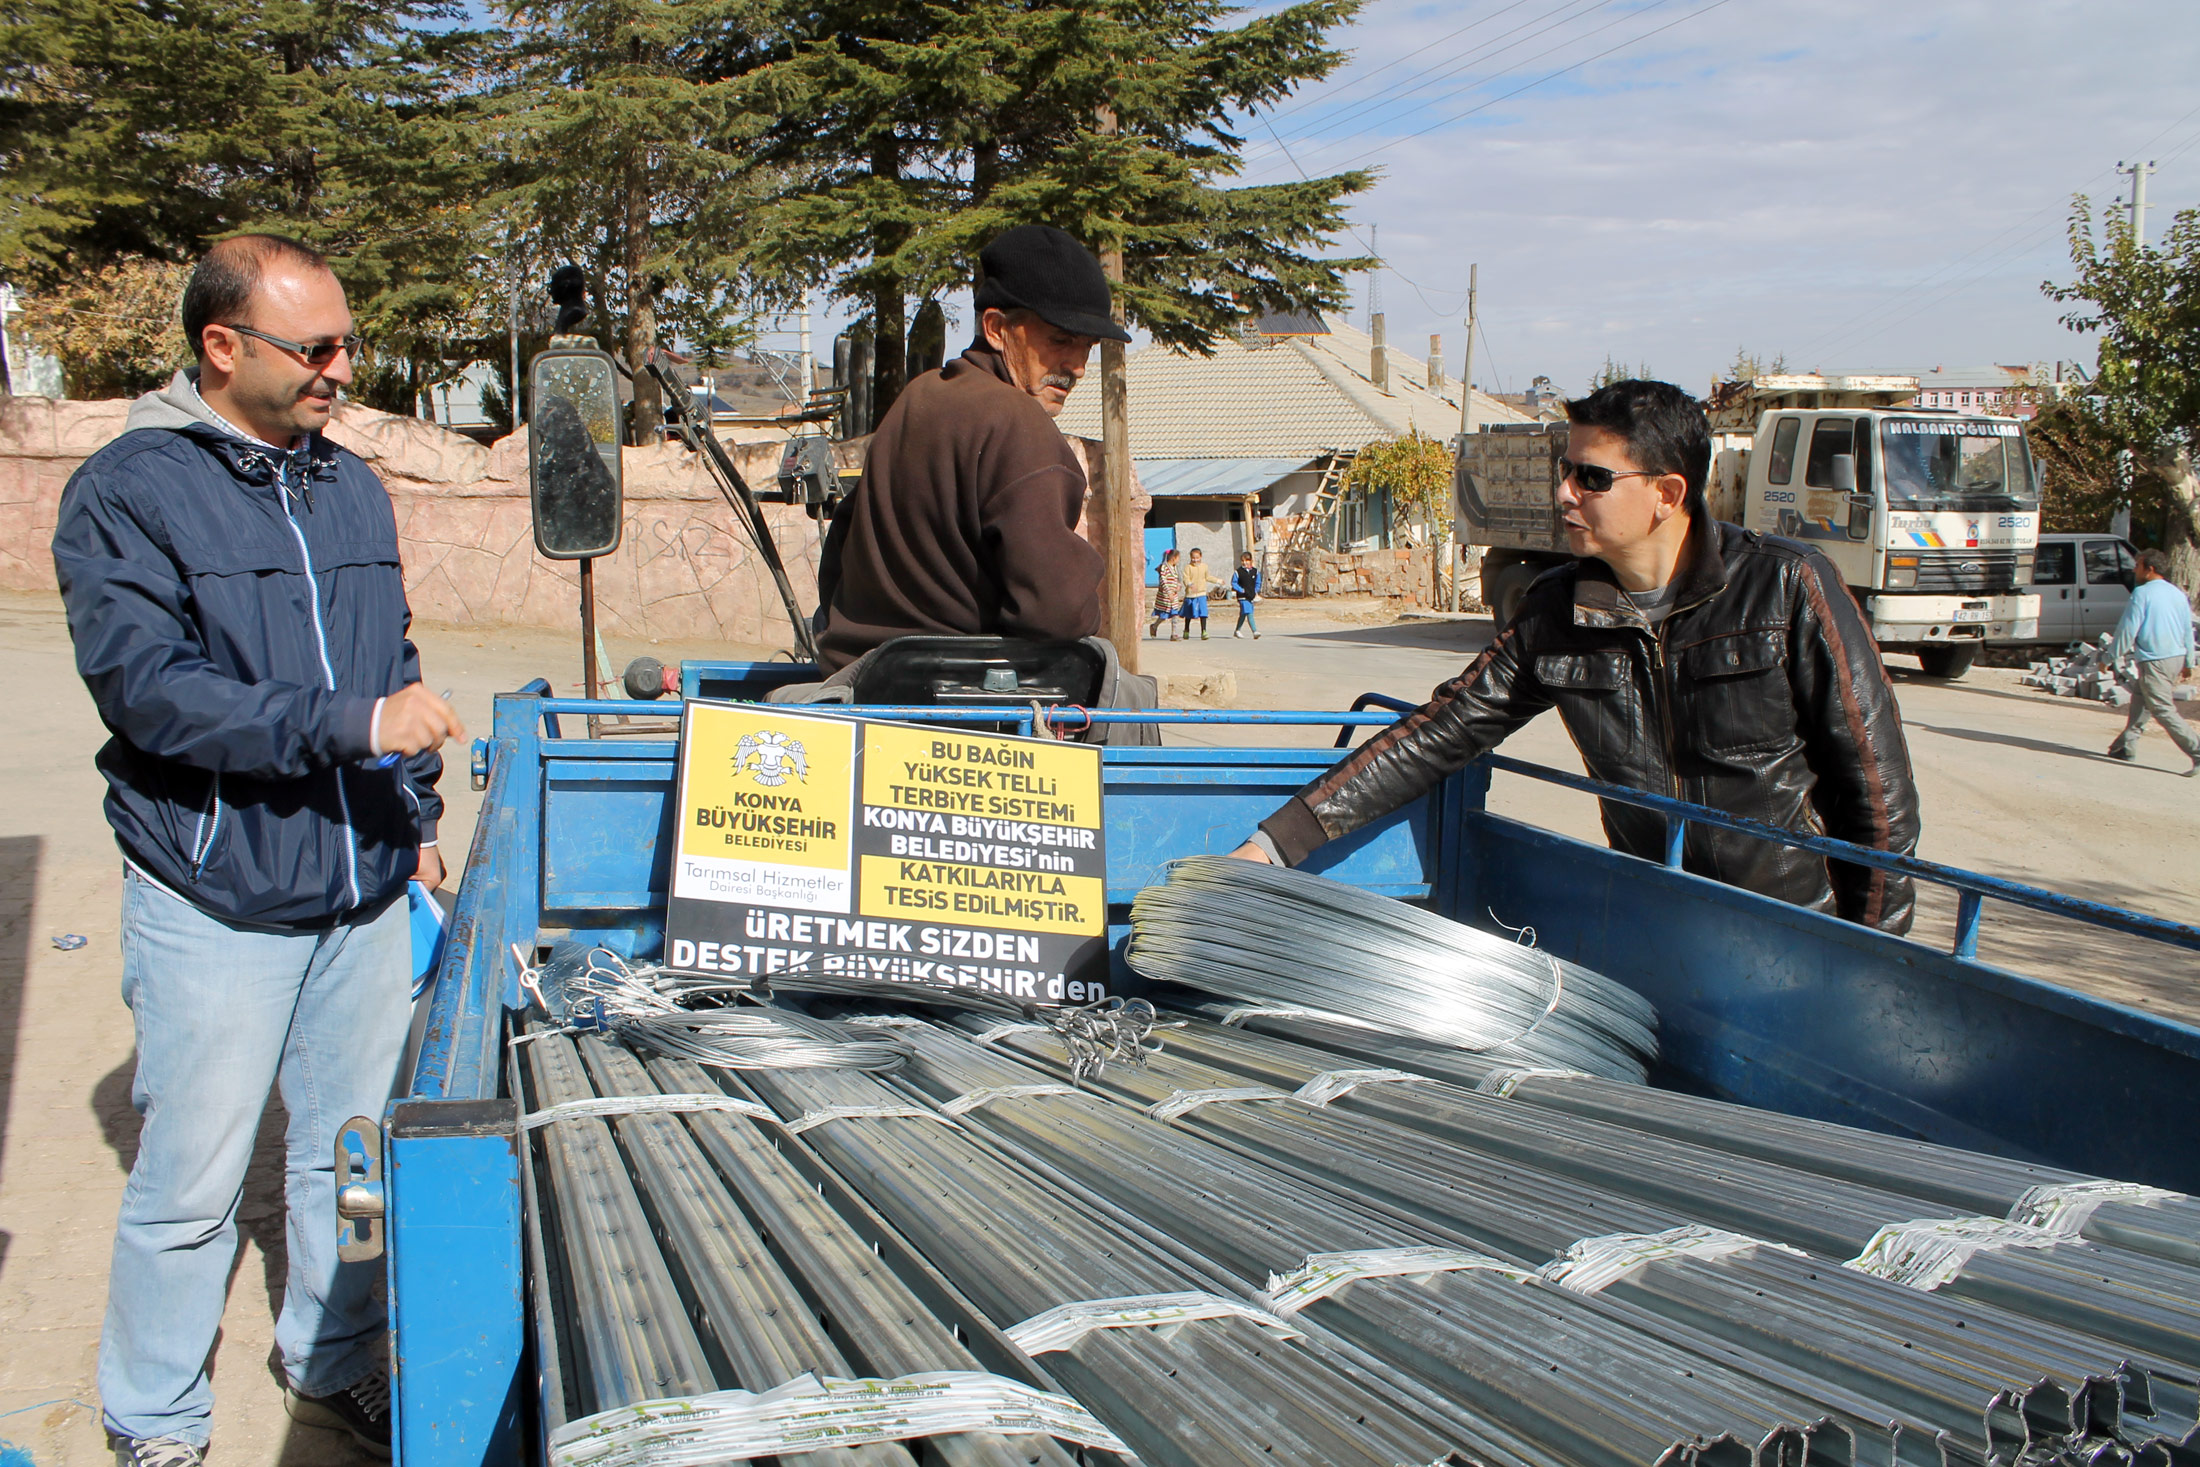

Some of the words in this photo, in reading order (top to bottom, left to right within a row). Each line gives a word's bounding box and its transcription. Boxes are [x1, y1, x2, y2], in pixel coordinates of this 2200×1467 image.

[1889, 421, 2021, 437] NALBANTOĞULLARI
[1763, 490, 1796, 503] 2520
[1890, 516, 1932, 529] Turbo
[1997, 516, 2031, 528] 2520
[931, 740, 962, 762] BU
[966, 743, 1035, 770] BAĞIN
[904, 761, 993, 789] YüKSEK
[997, 772, 1057, 797] TELLi
[733, 791, 803, 813] KONYA
[889, 784, 985, 813] TERBiYE
[988, 795, 1076, 823] SiSTEMi
[696, 805, 837, 840] BÜYÜKŞEHİR
[863, 806, 948, 834] KONYA
[950, 815, 1097, 850] BüYüKŞEHiR
[724, 833, 808, 853] BELEDİYESİ
[684, 861, 757, 884] Tarımsal
[763, 870, 844, 892] Hizmetler
[709, 880, 752, 895] Dairesi
[756, 884, 818, 903] Başkanlığı
[899, 861, 1067, 896] KATKILARIYLA
[883, 885, 949, 911] TESiS
[744, 908, 913, 952] üRETMEK
[919, 927, 1040, 964] SiZDEN
[671, 938, 814, 977] DESTEK
